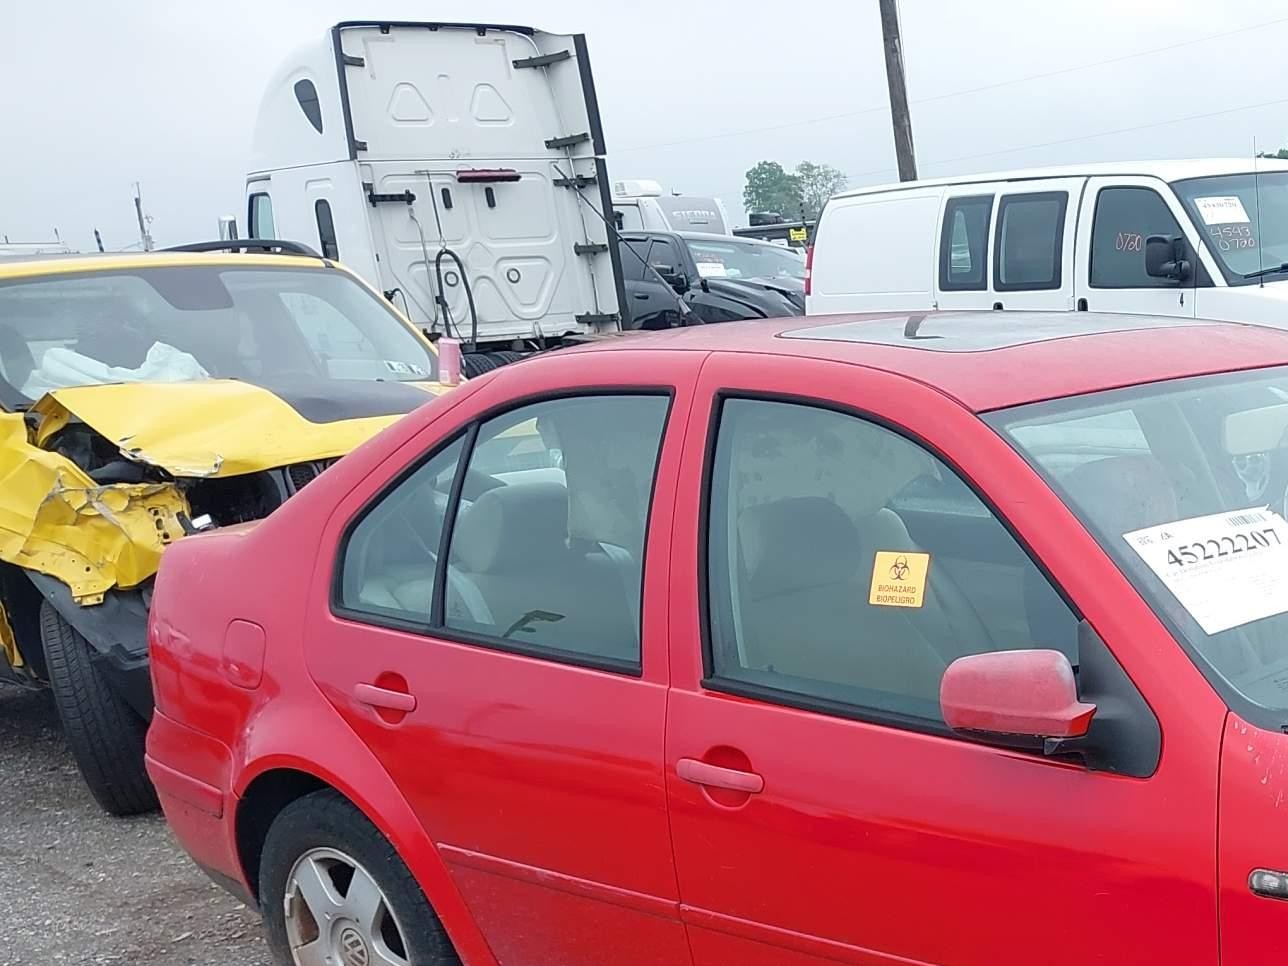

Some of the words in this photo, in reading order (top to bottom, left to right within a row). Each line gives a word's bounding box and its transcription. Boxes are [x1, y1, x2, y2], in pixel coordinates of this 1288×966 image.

[1116, 232, 1142, 251] 0720
[1166, 528, 1282, 567] 45222207
[878, 584, 916, 594] BIOHAZARD
[876, 594, 916, 604] BIOPELIGRO
